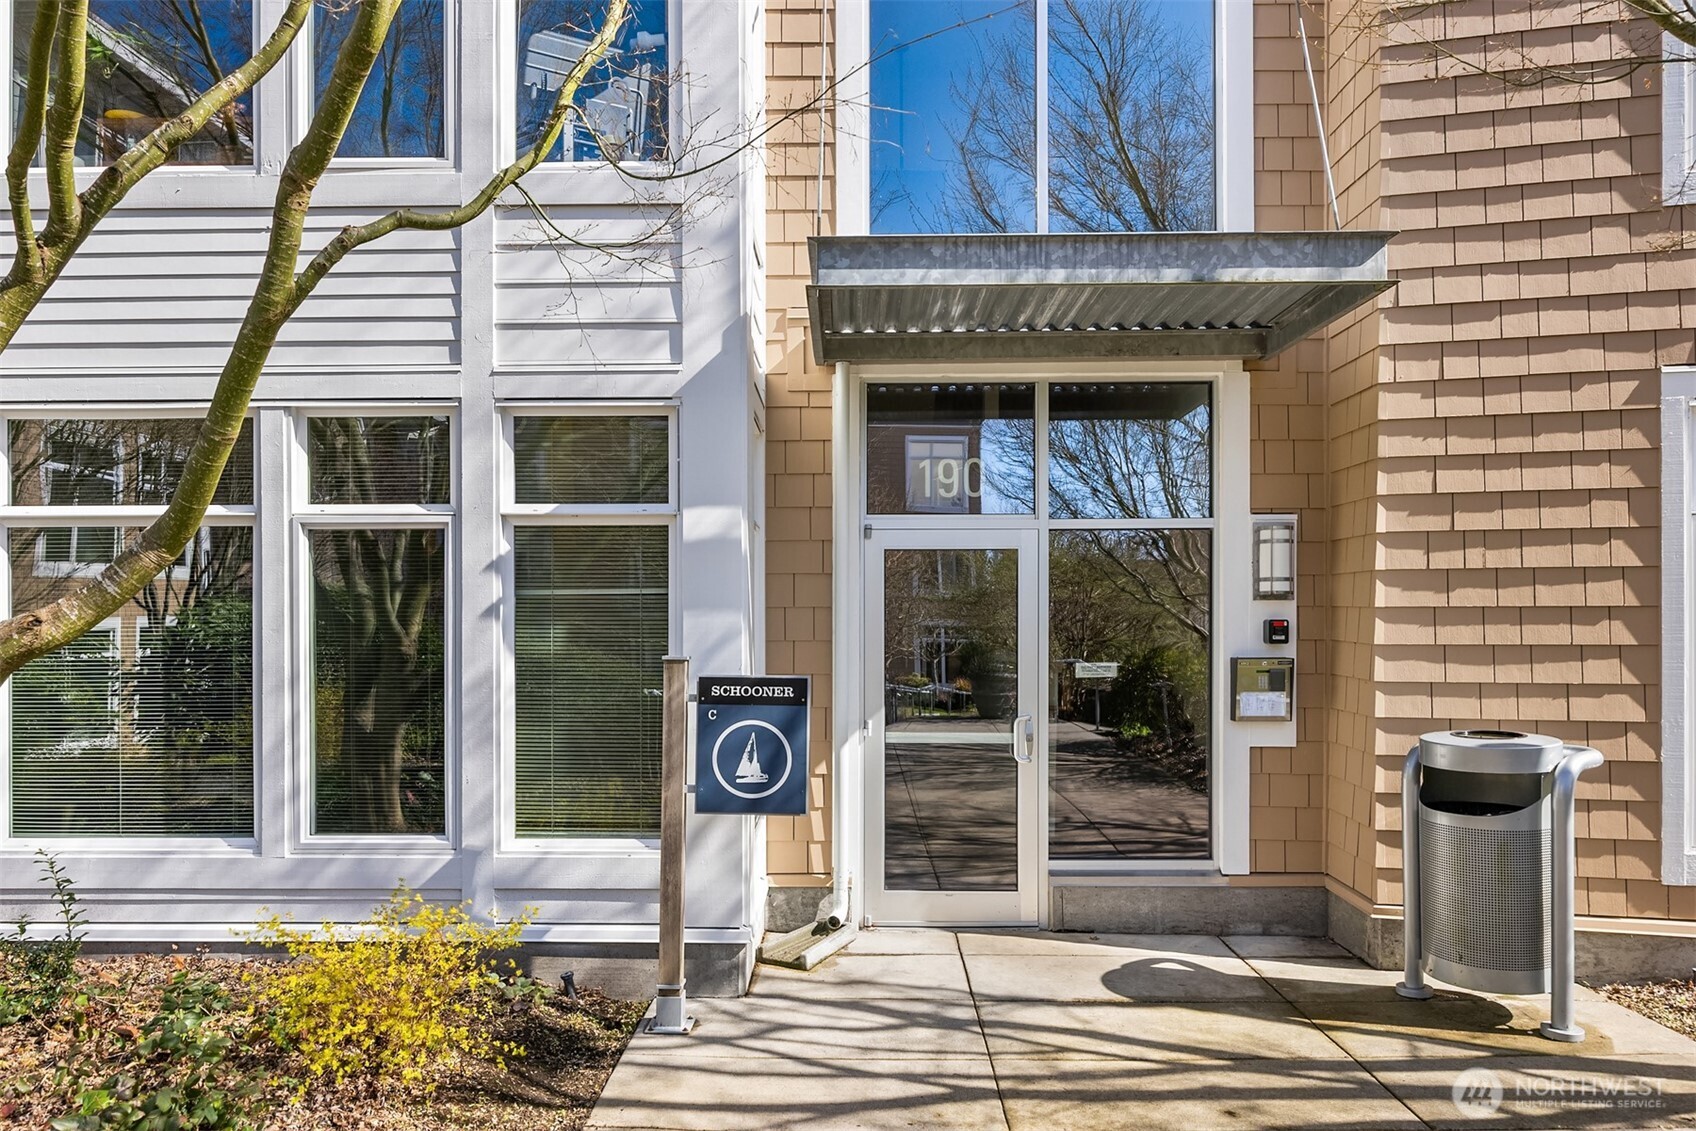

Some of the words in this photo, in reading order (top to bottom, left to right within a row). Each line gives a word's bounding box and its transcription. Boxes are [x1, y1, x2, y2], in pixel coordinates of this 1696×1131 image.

[919, 458, 983, 498] 190
[711, 685, 794, 697] SCHOONER
[708, 709, 717, 720] C
